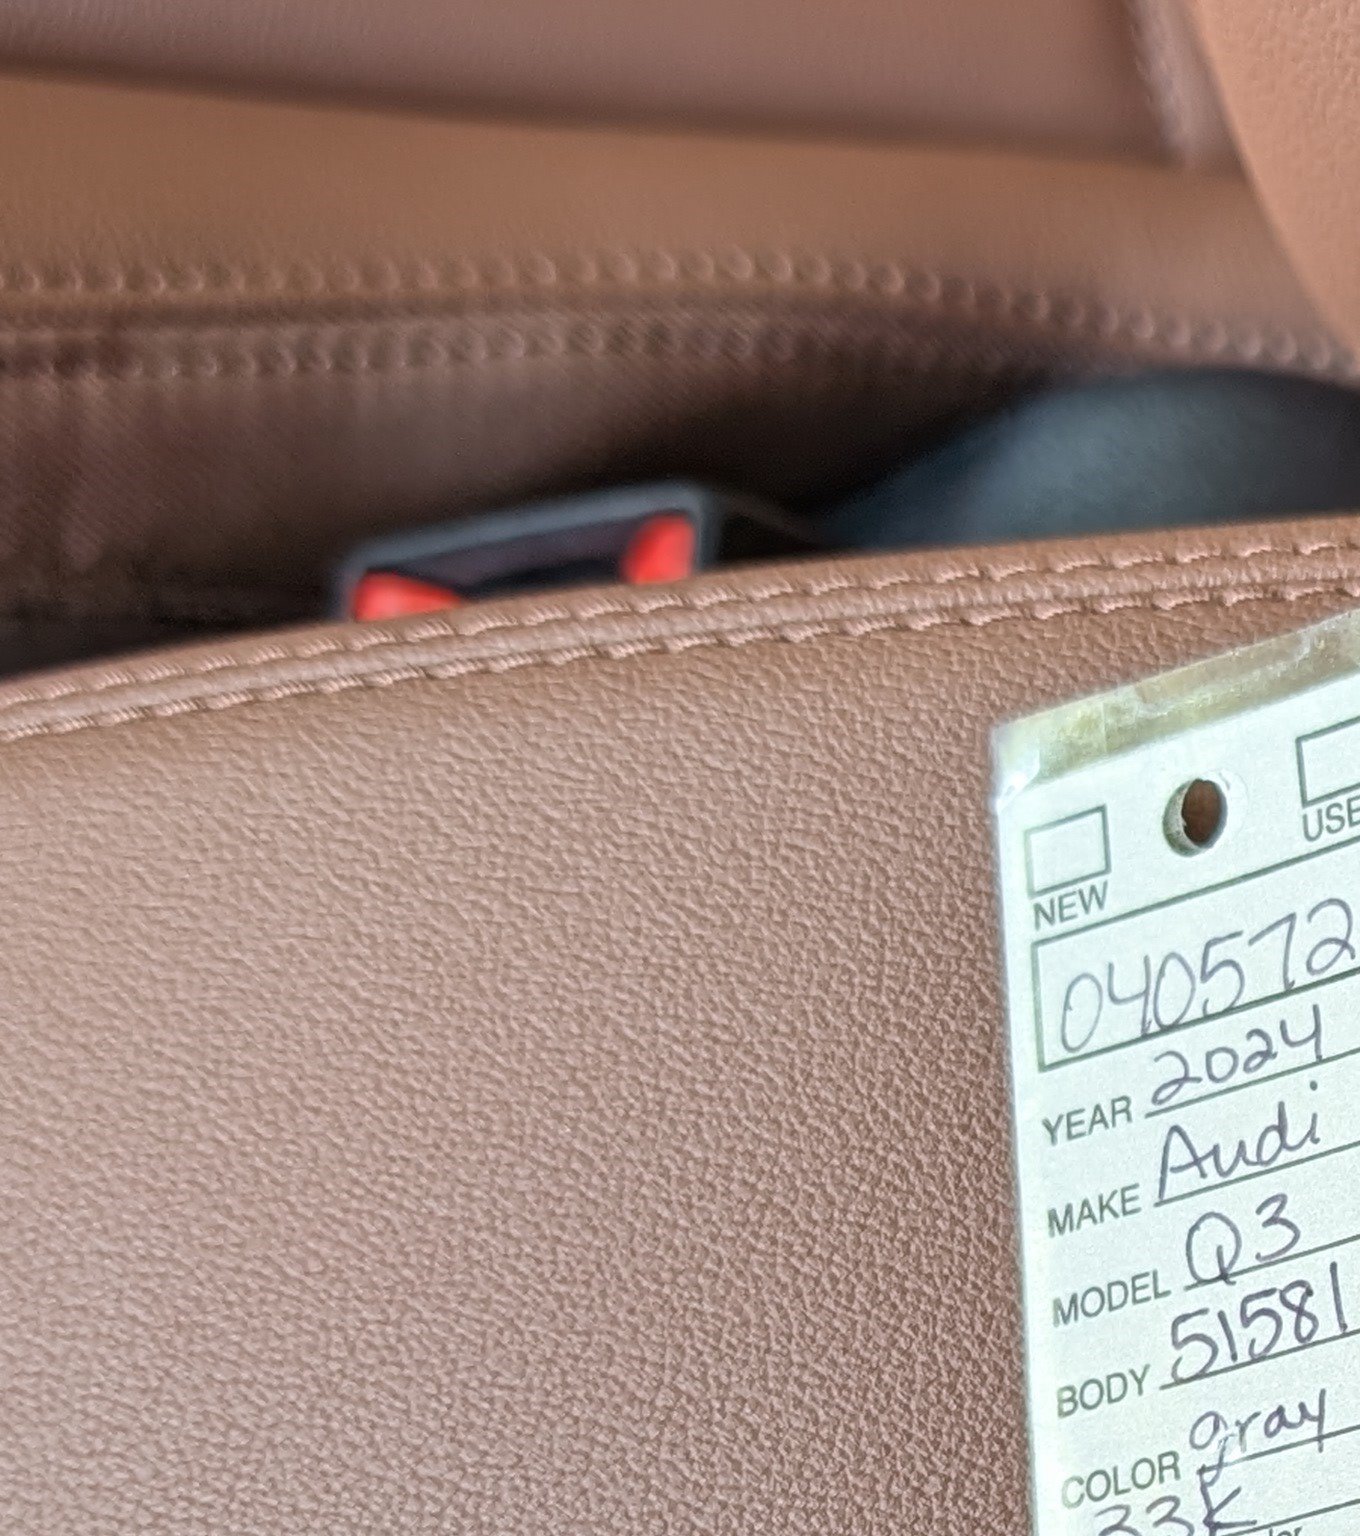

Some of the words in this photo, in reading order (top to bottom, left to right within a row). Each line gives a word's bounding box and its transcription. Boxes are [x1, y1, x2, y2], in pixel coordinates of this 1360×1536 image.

[1033, 881, 1109, 930] NEW
[1061, 898, 1355, 1052] 040572
[1151, 1004, 1324, 1106] 2024
[1042, 1096, 1133, 1147] YEAR
[1158, 1081, 1320, 1200] Audi
[1047, 1183, 1142, 1237] MAKE
[1052, 1269, 1171, 1327] MODEL
[1170, 1261, 1349, 1383] 51581
[1057, 1364, 1150, 1418] BODY
[1189, 1388, 1326, 1487] gray
[1061, 1450, 1181, 1509] COLOR
